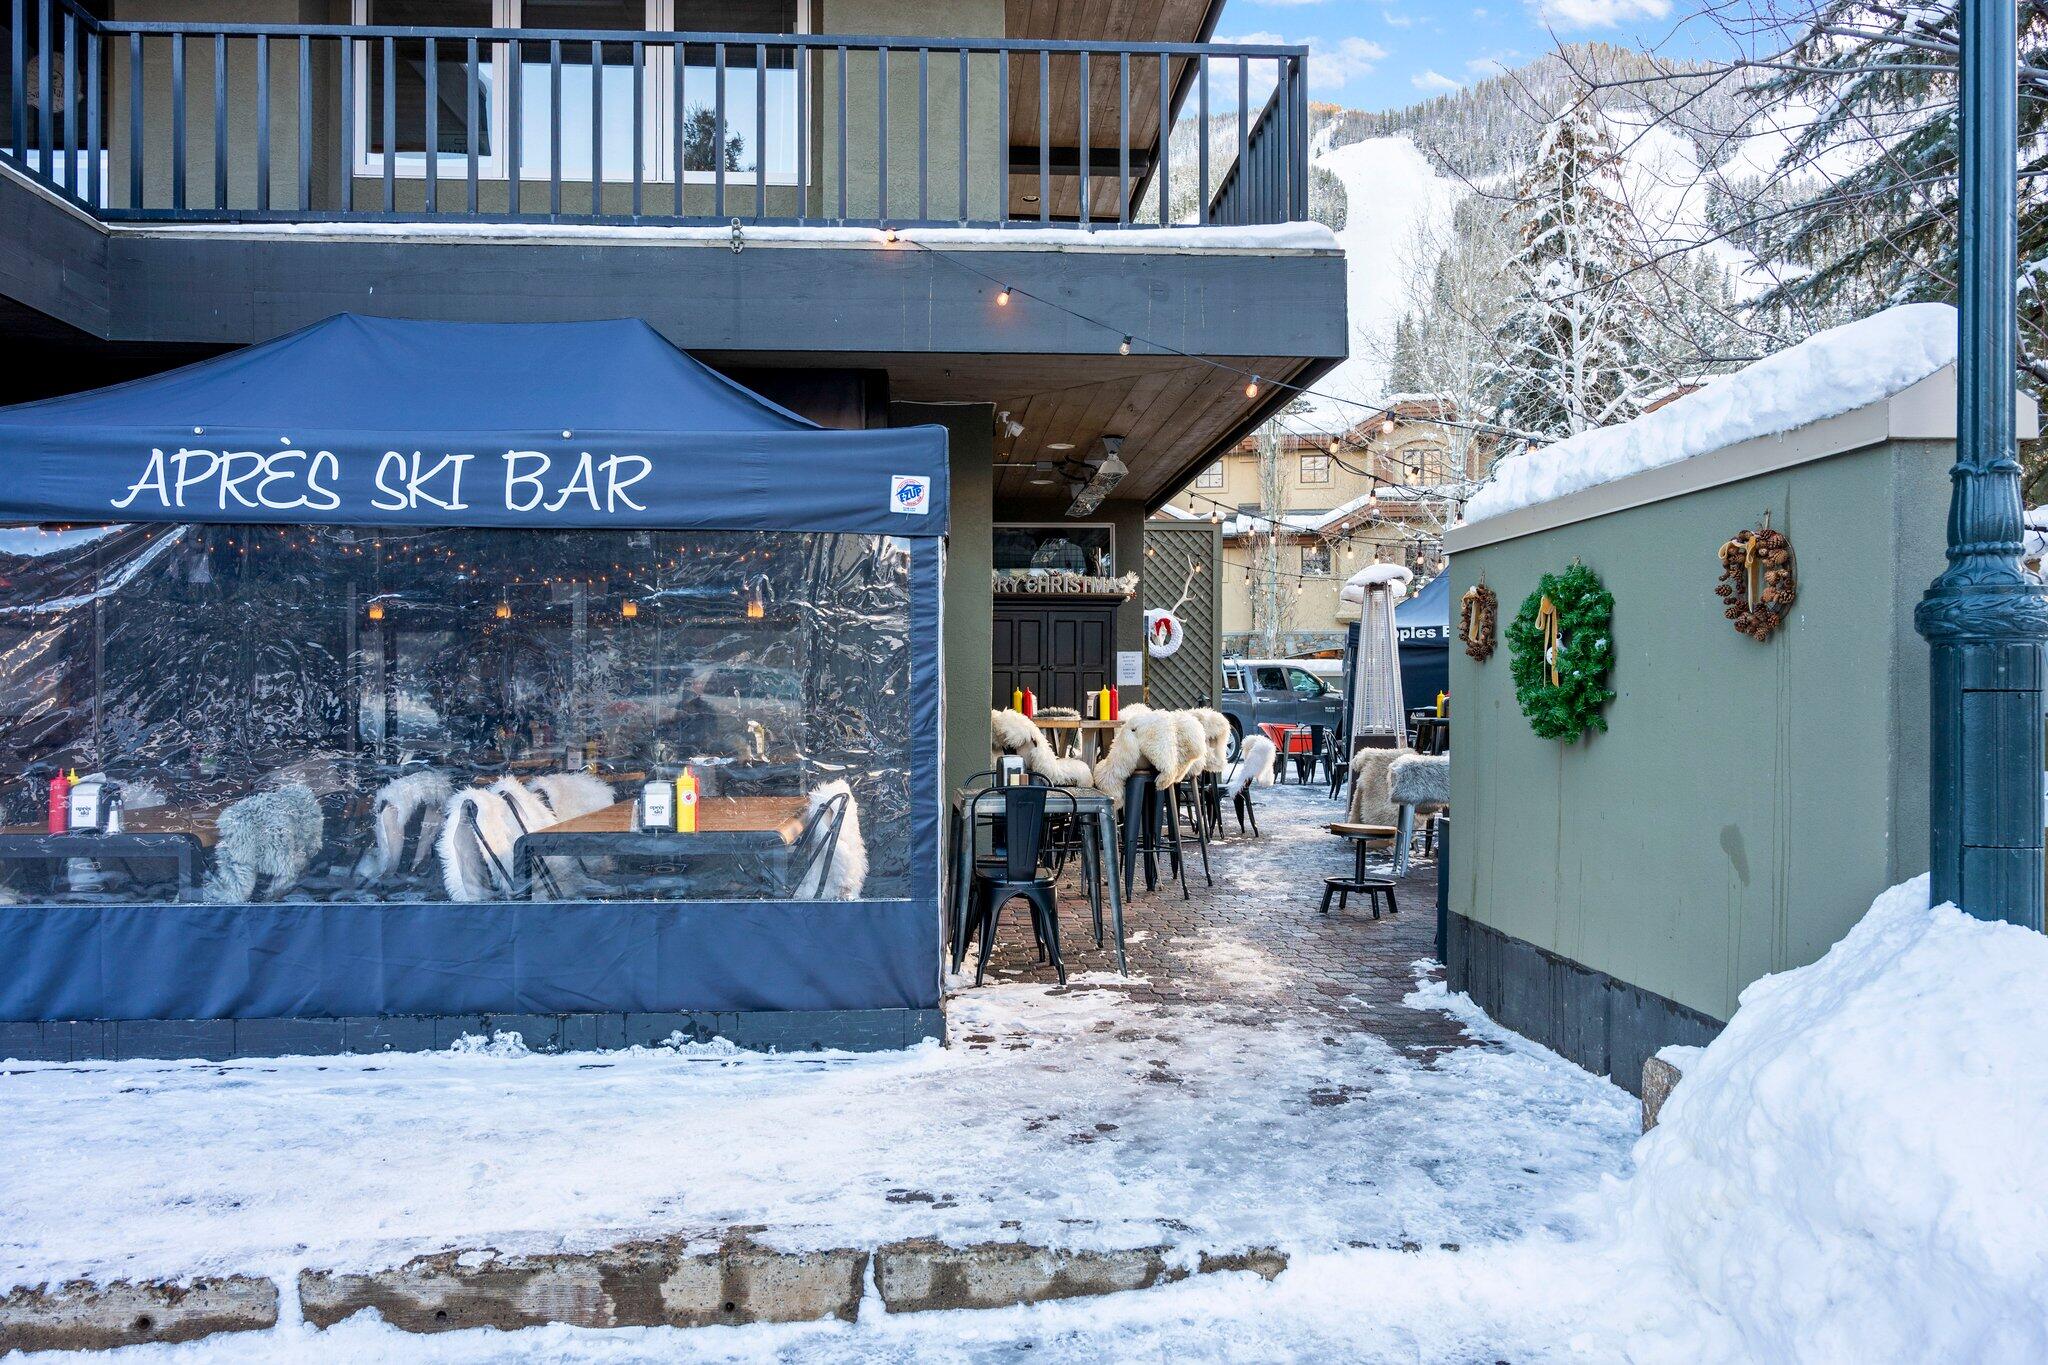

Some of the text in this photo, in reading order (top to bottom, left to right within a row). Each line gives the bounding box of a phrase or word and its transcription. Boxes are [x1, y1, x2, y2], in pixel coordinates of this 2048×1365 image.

[110, 436, 652, 513] APRÈS SKI BAR
